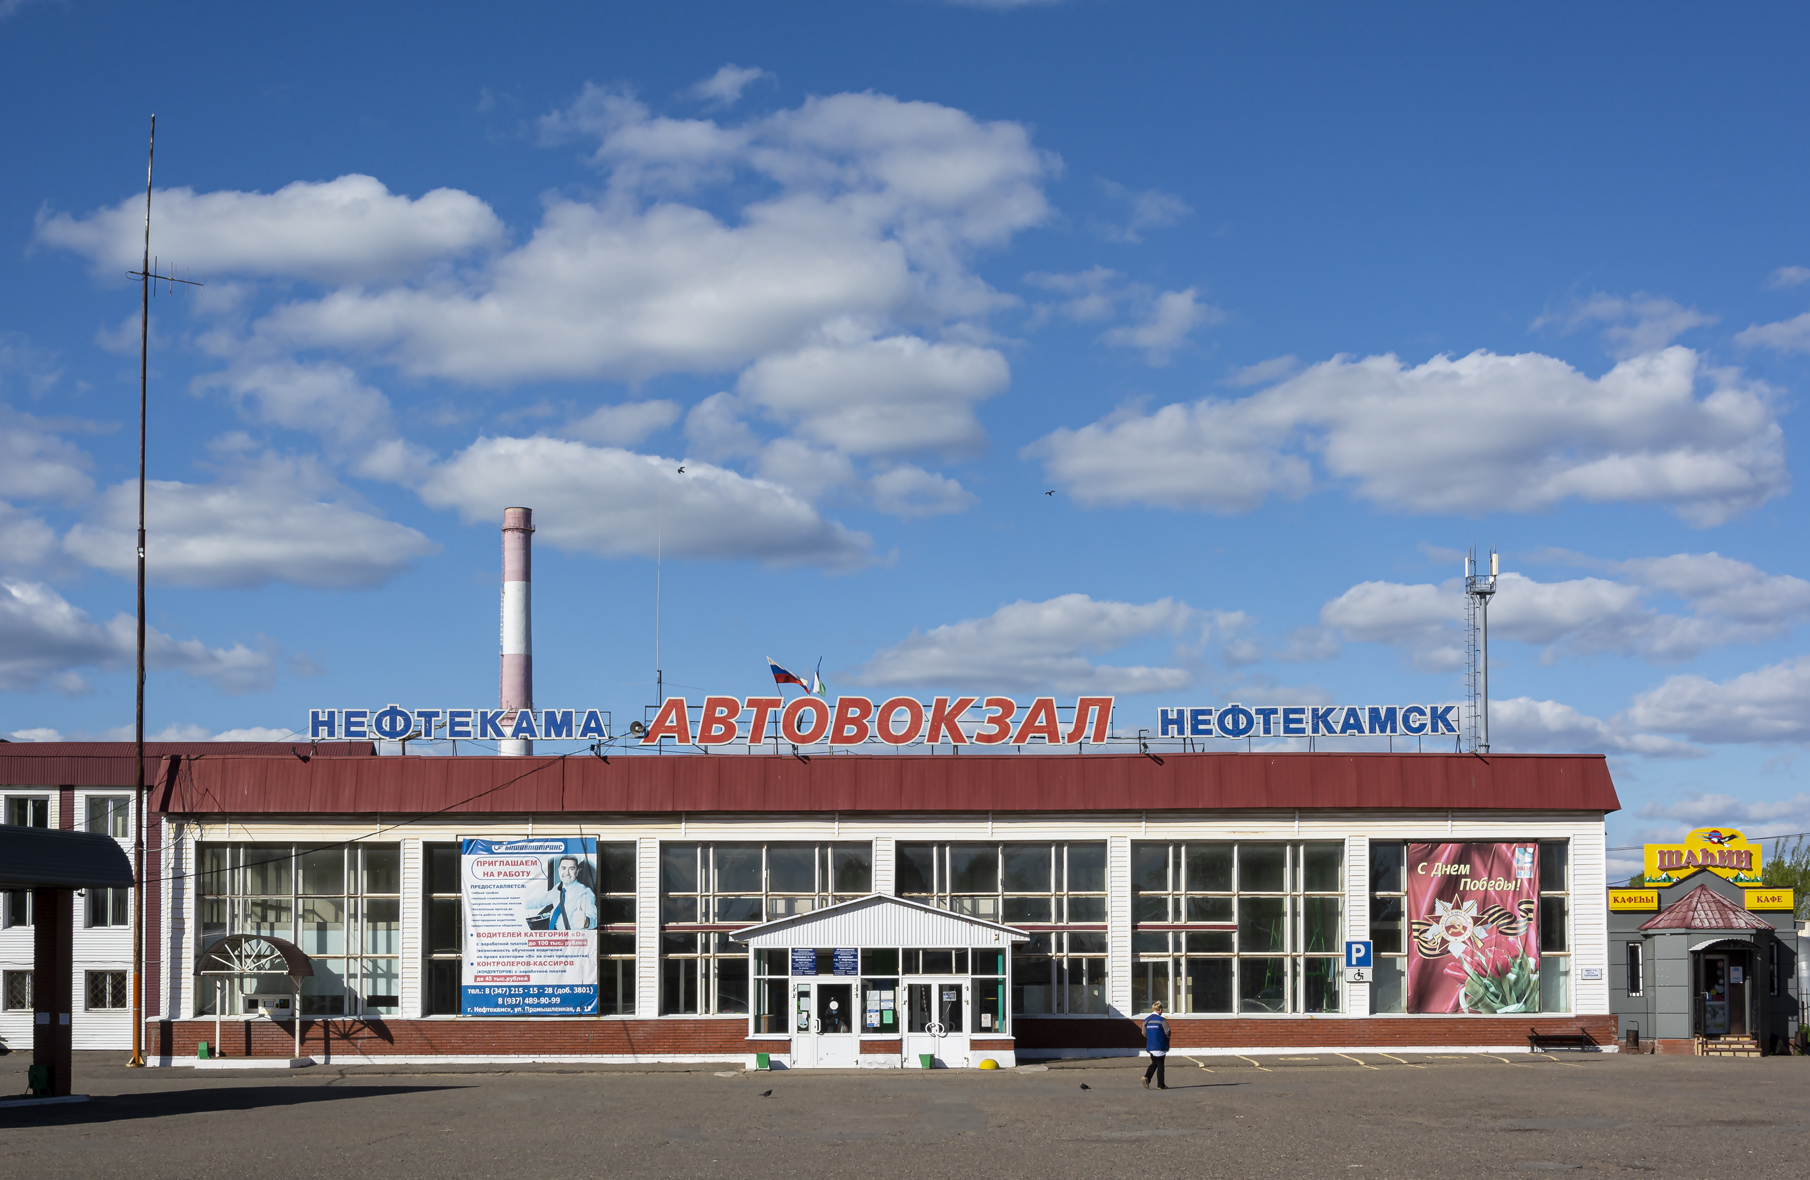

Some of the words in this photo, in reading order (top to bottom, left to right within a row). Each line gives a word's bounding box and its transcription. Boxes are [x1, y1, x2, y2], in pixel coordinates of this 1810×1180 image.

[309, 704, 609, 741] НЕФТЕКАМА
[638, 696, 1115, 746] АВТОВОКЗАЛ
[1158, 703, 1460, 740] НЕФТЕКАМСК
[1417, 862, 1428, 874] С
[1430, 862, 1470, 877] Днем
[1460, 877, 1521, 891] Победы!
